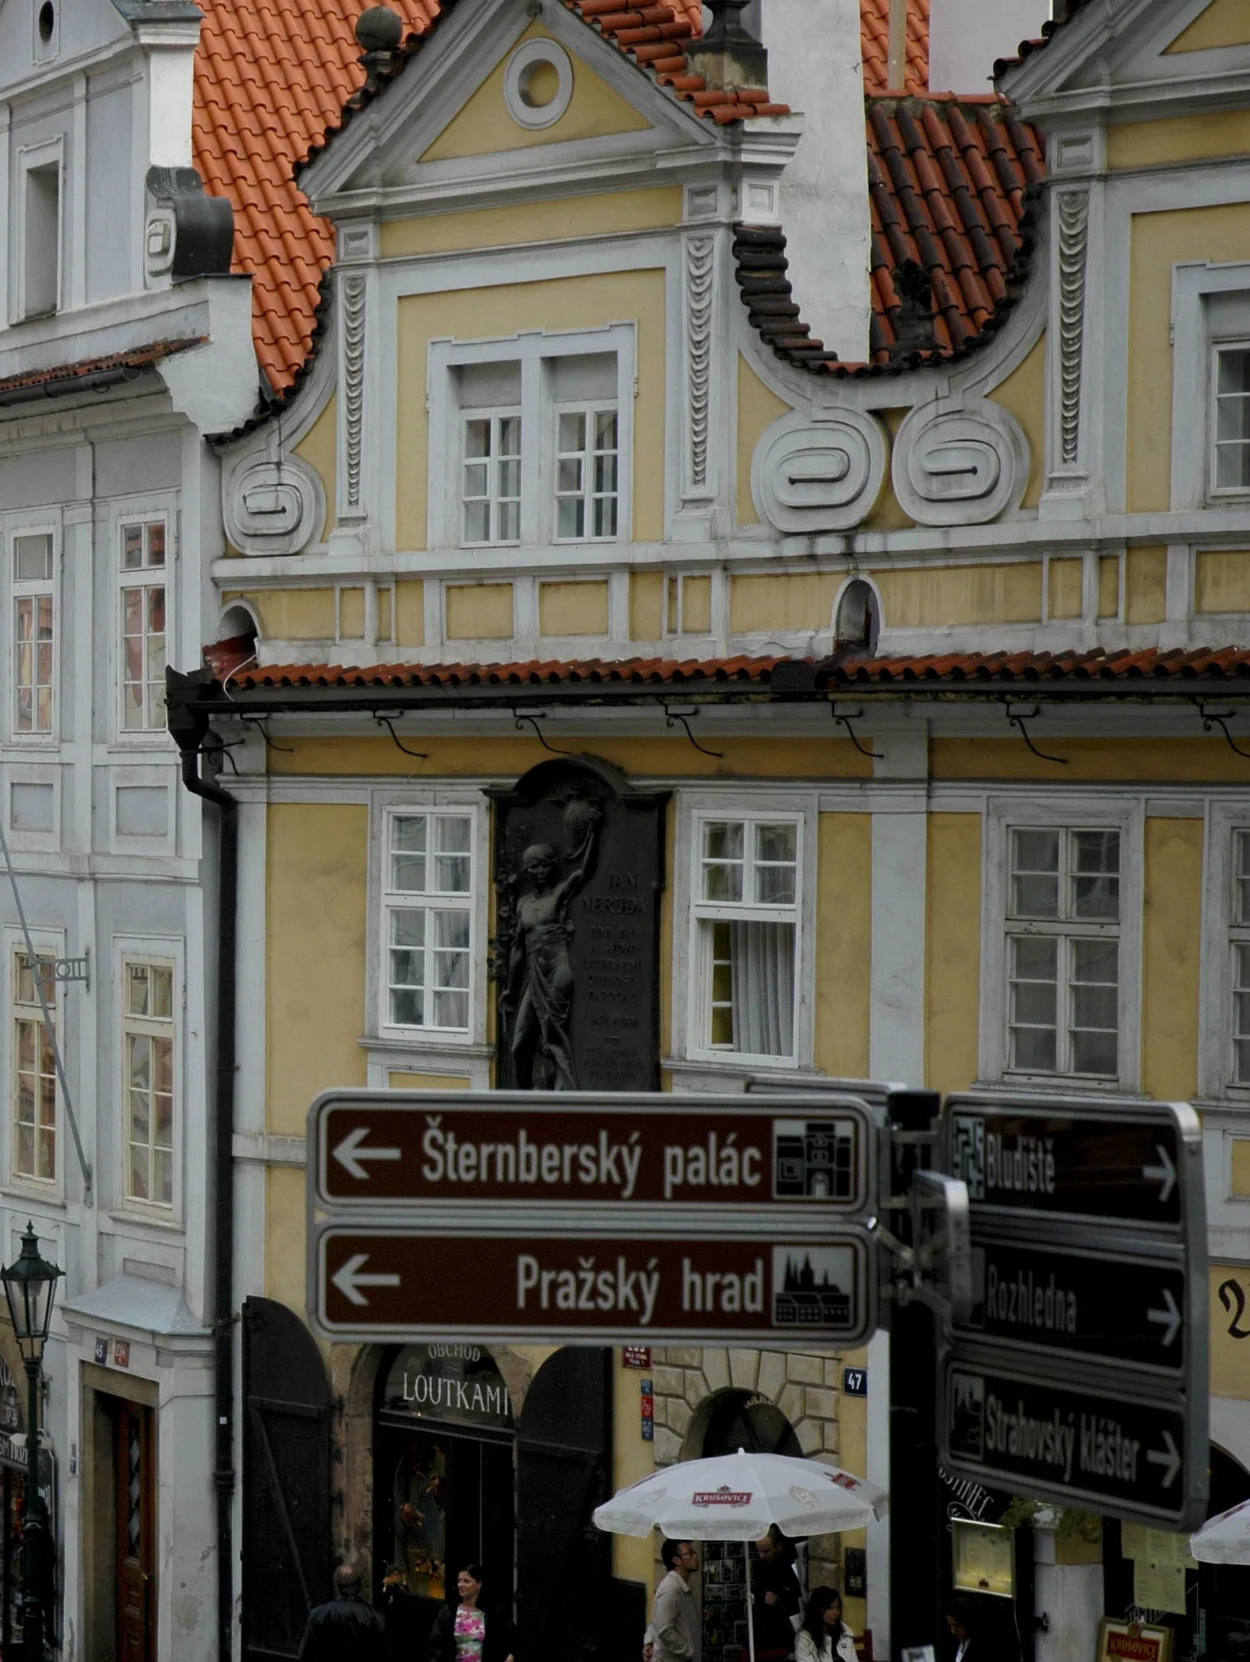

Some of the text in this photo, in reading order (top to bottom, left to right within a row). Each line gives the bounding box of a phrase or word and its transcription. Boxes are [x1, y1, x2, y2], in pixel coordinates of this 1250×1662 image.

[422, 1114, 763, 1200] Šternberský palác
[516, 1253, 765, 1325] Pražský hrad
[987, 1264, 1078, 1333] Rozhledna
[428, 1344, 482, 1363] OBCHOD
[848, 1372, 862, 1391] 47
[403, 1372, 510, 1416] LOUTKAMI
[985, 1393, 1141, 1484] Strahovský klášter
